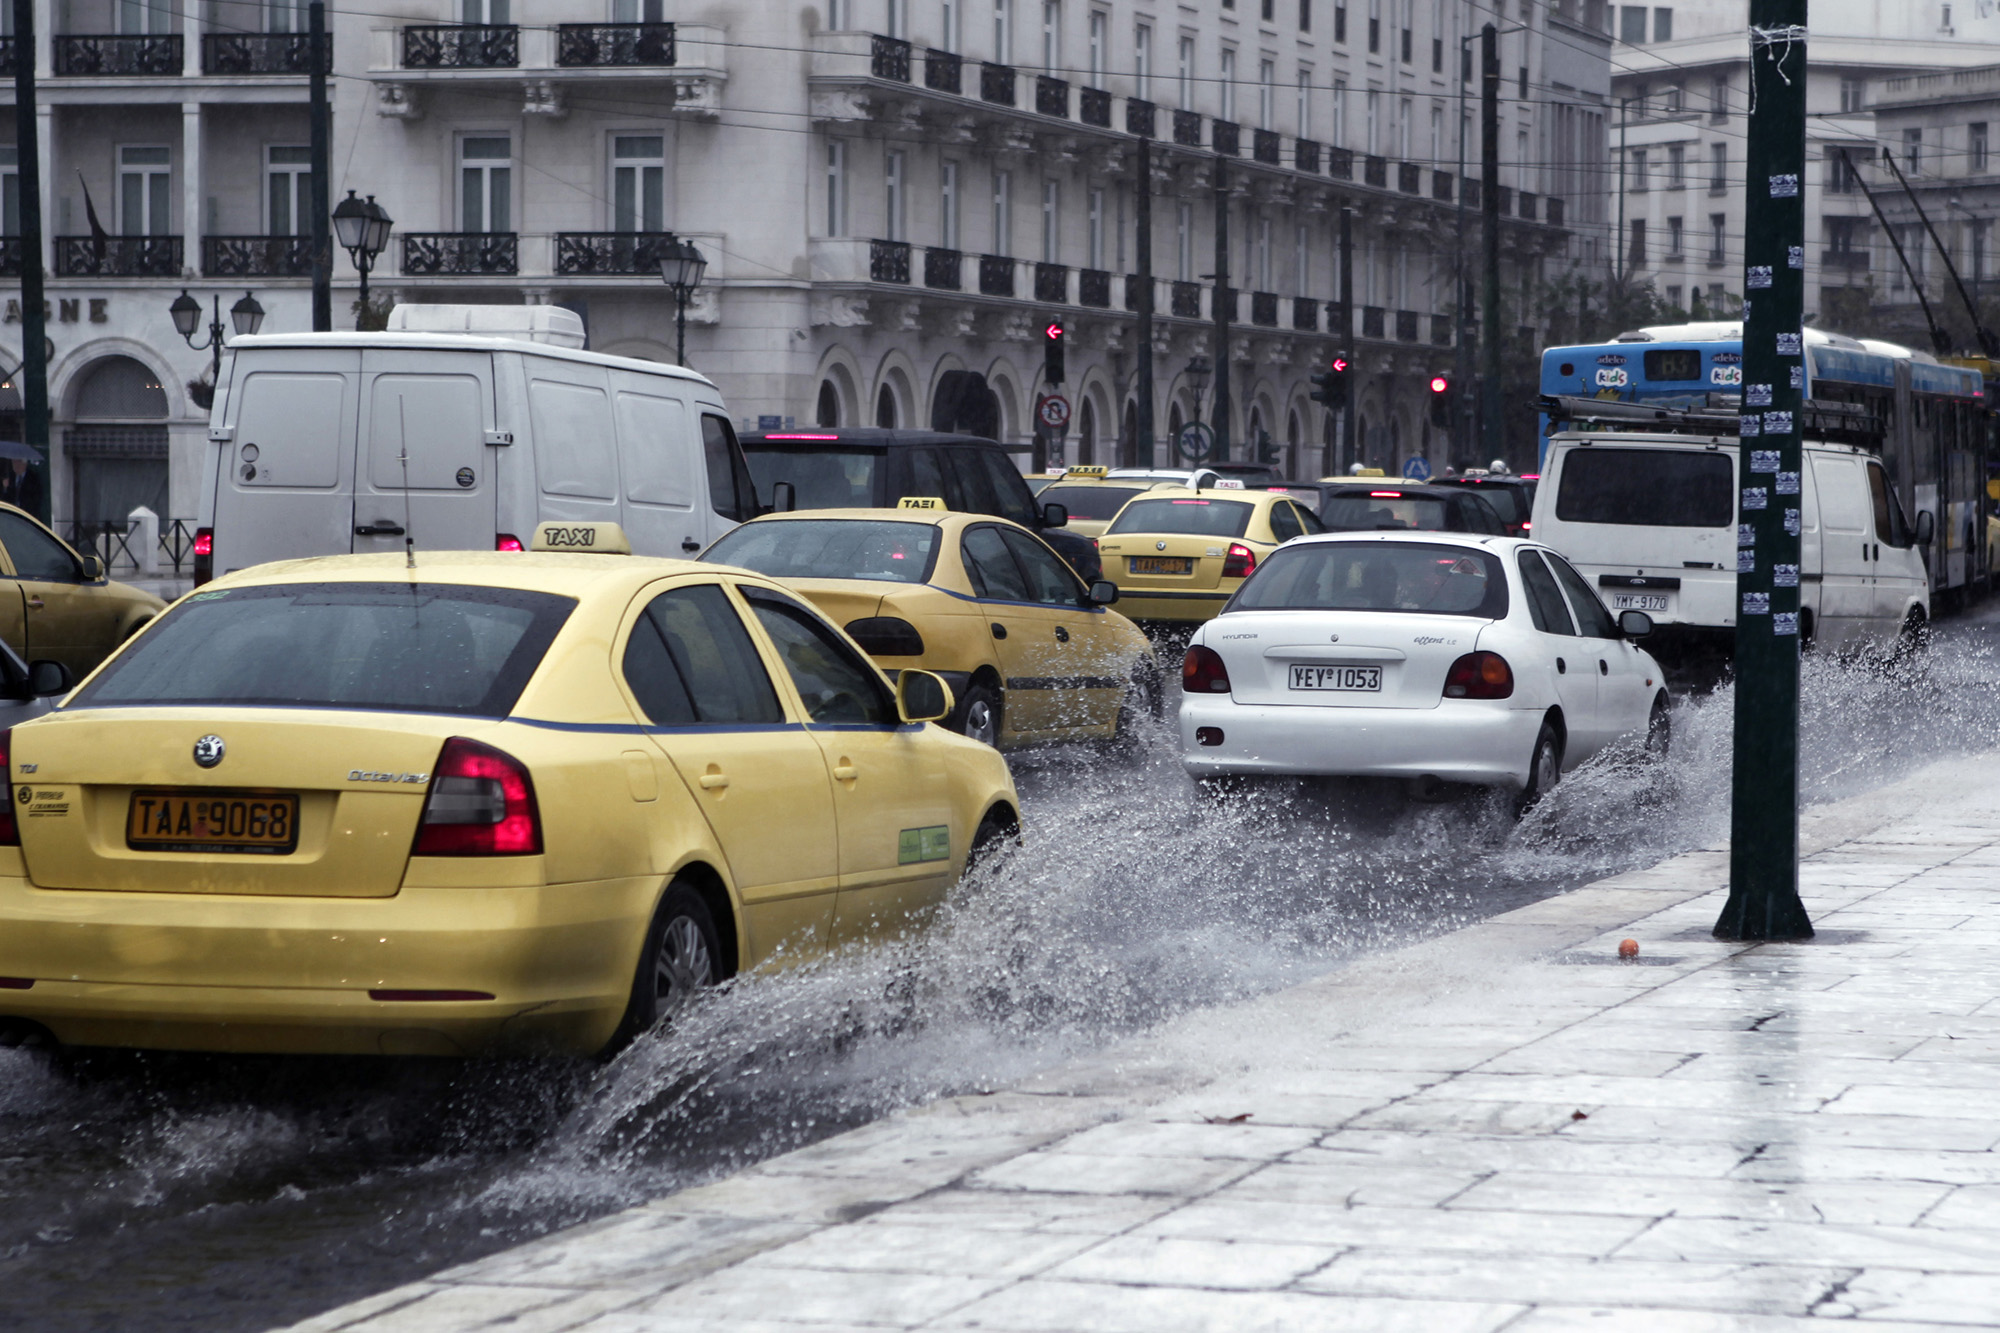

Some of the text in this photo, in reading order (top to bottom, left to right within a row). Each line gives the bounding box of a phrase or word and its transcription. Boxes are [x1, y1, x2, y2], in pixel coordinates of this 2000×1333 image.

[1596, 355, 1627, 364] adelco
[1711, 353, 1742, 363] adelco
[1599, 369, 1625, 384] kids
[1713, 368, 1740, 382] kids
[544, 528, 596, 546] TAXI
[1615, 595, 1667, 610] YMY-9170
